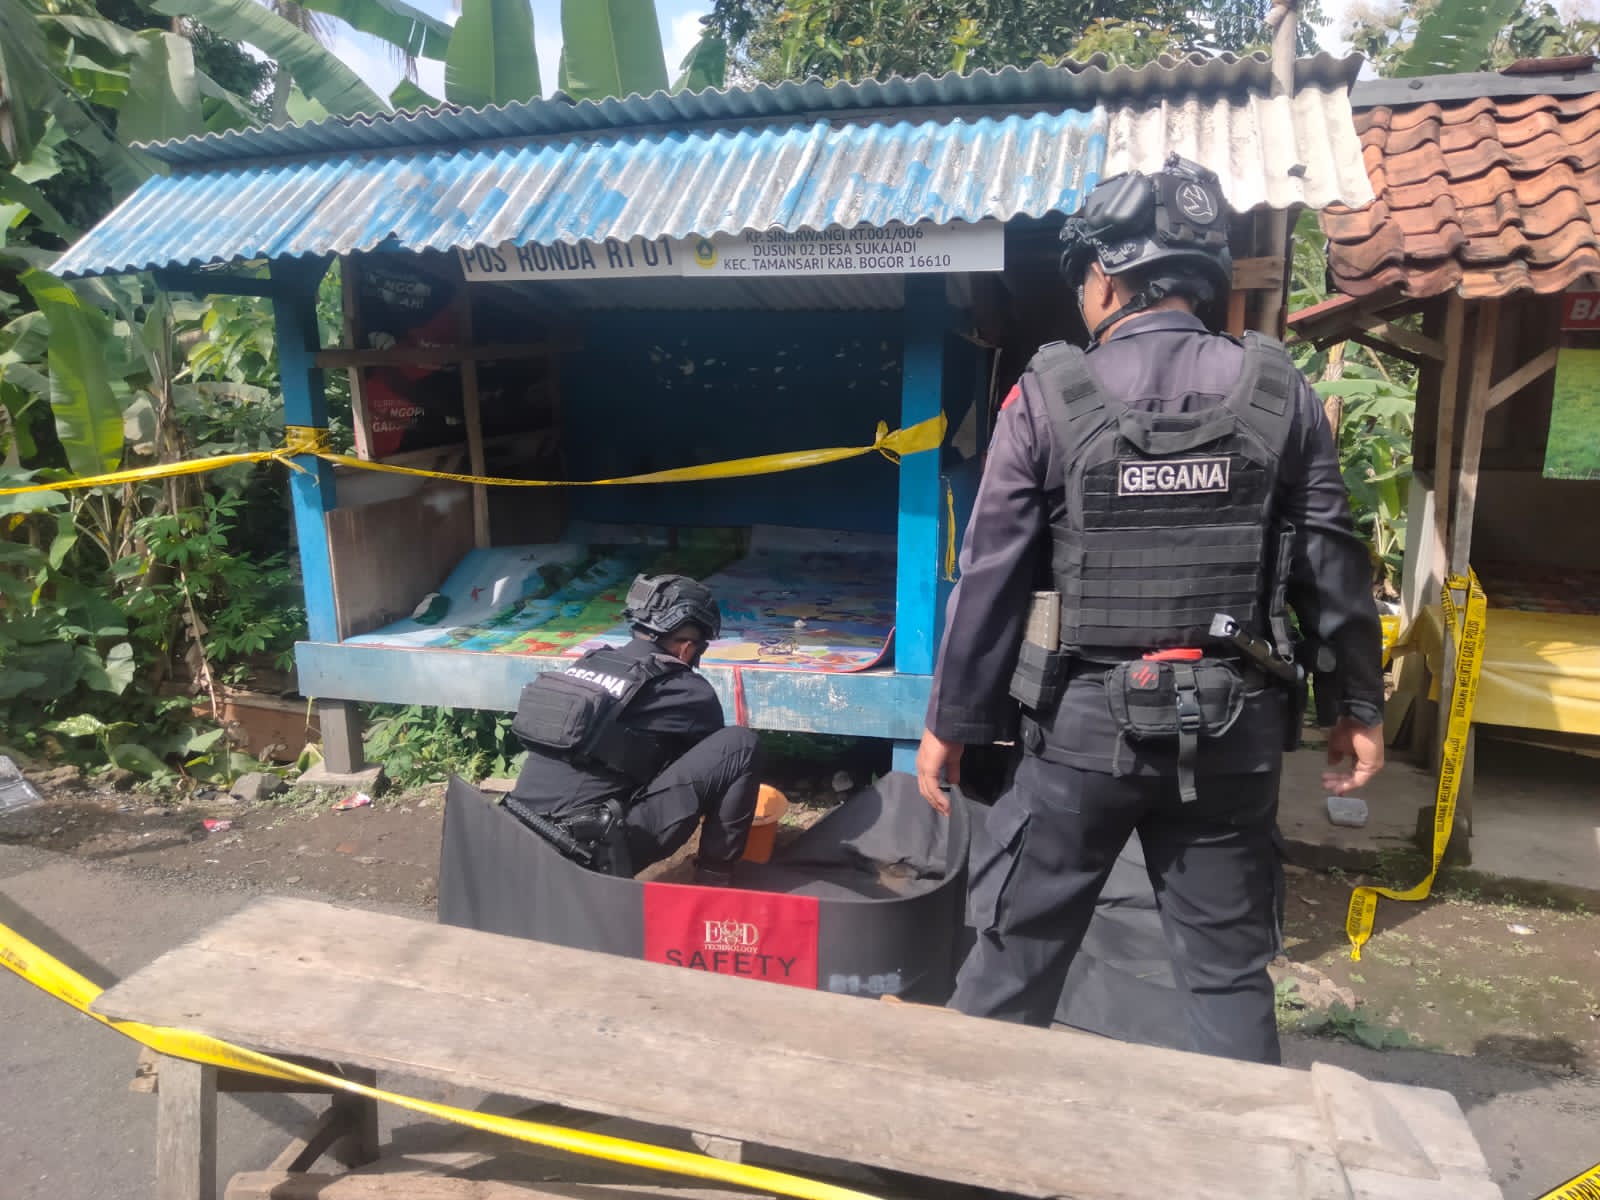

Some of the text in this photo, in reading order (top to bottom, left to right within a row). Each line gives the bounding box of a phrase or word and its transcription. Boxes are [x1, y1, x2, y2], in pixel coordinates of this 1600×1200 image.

[850, 226, 924, 241] RT.001/006
[465, 246, 507, 272] POS
[517, 239, 596, 272] RONDA
[753, 241, 917, 257] DUSUN 02 DESA SUKAJADI
[724, 255, 951, 270] KEC. TAMANSARI KAB. BOGOR 16610
[1123, 463, 1225, 491] GEGANA
[1465, 619, 1480, 639] POLISI
[1462, 640, 1475, 658] GARIS
[1458, 659, 1473, 688] MELINTAS
[704, 943, 758, 953] TECHNOLOGY
[665, 948, 797, 977] SAFETY
